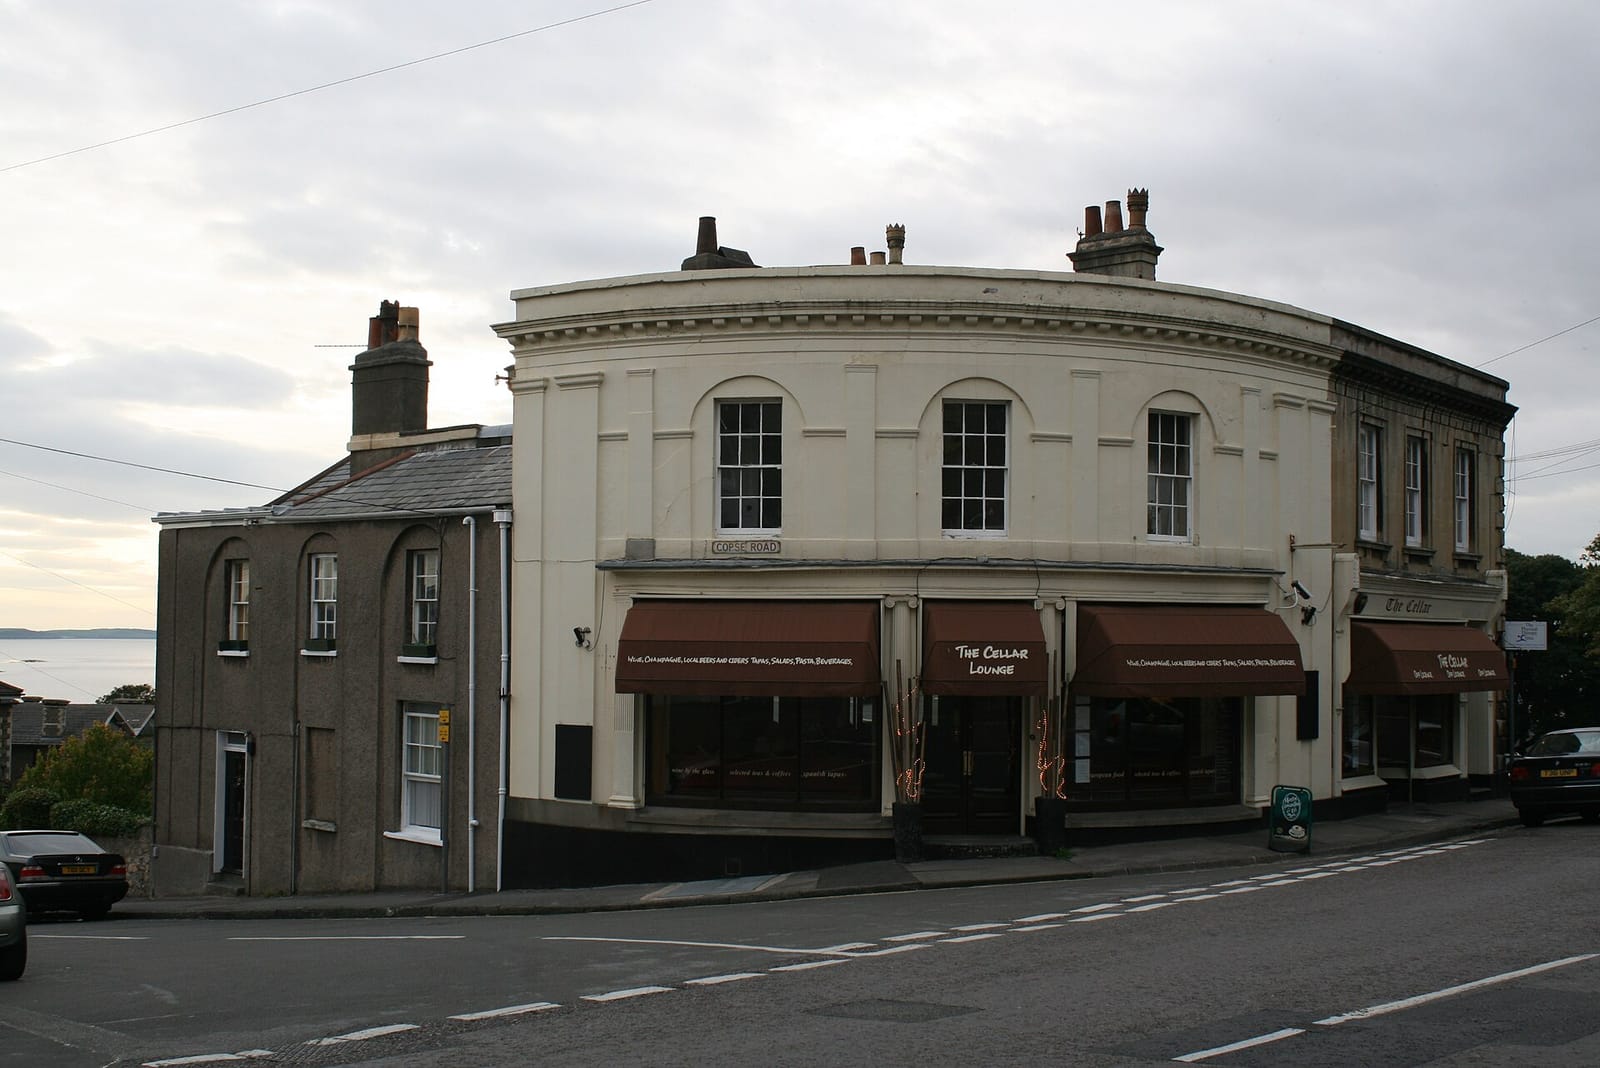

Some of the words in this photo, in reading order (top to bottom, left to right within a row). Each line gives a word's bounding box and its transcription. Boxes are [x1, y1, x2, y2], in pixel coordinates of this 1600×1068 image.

[716, 542, 745, 552] COPSE
[750, 542, 777, 552] ROAD
[1385, 598, 1404, 612] The
[1406, 599, 1433, 614] Cellar
[983, 645, 1029, 660] CELLAR
[969, 661, 1015, 675] LOUNGE
